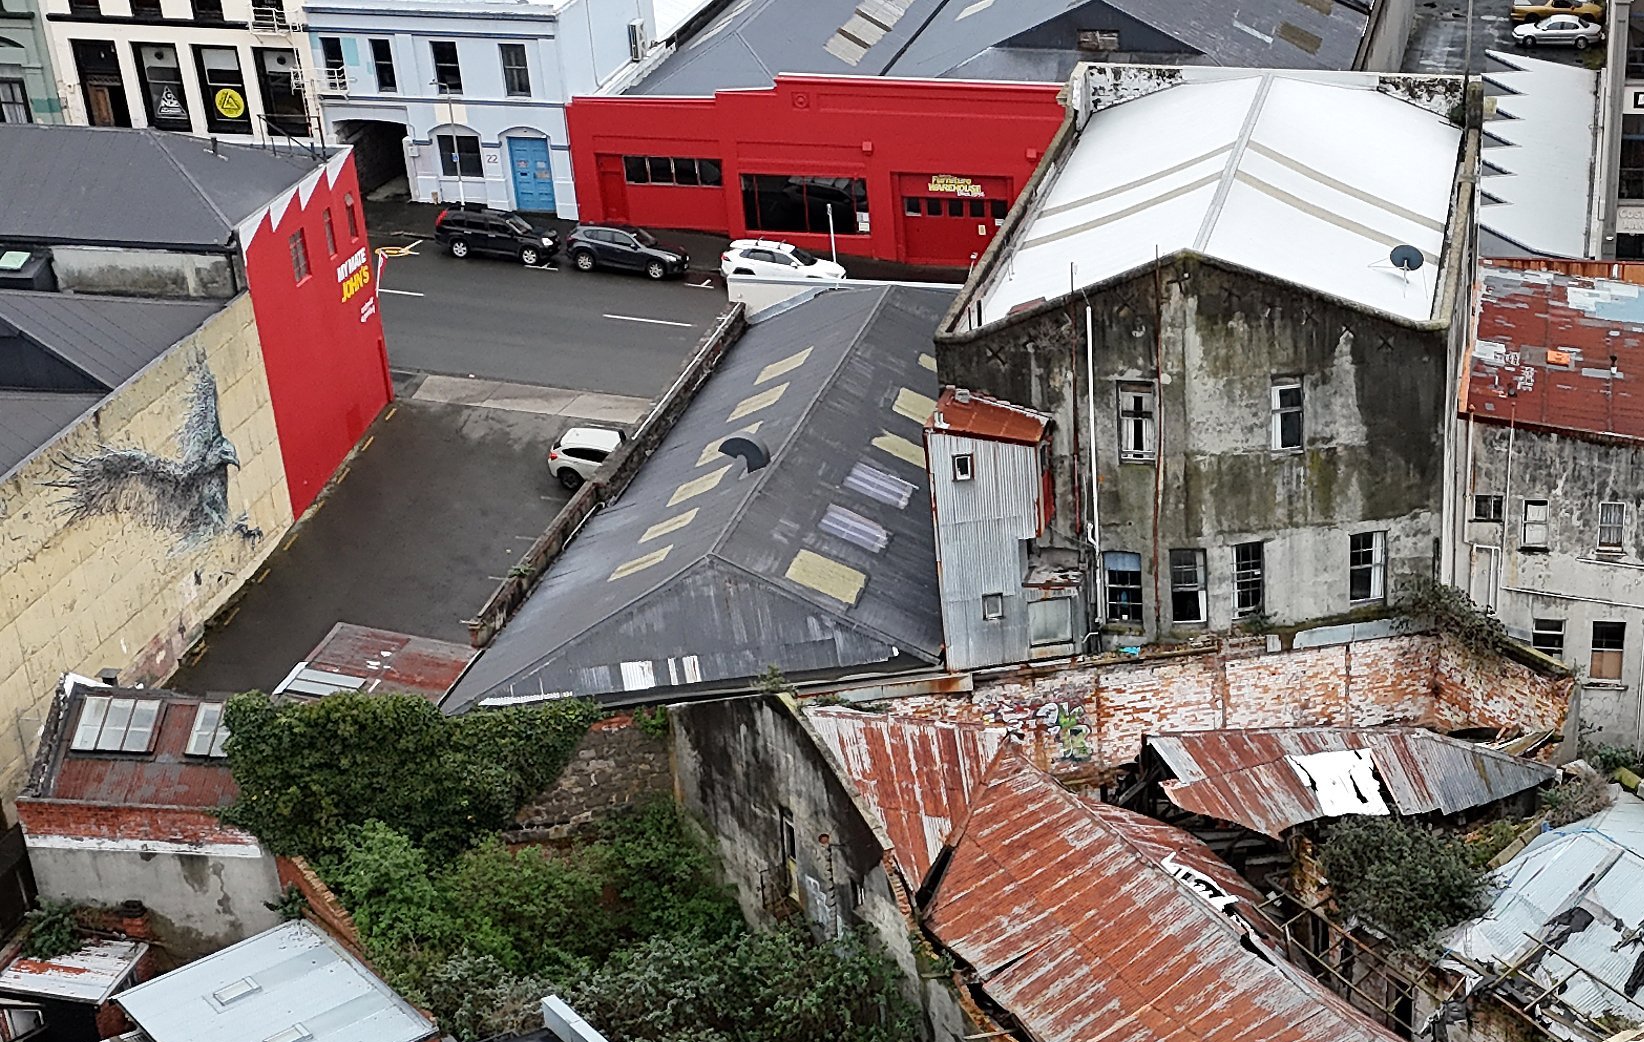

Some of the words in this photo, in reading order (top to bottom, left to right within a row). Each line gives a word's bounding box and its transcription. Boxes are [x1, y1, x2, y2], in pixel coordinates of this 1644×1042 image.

[486, 154, 499, 164] 22
[928, 183, 982, 193] WAREHOUSE
[342, 264, 370, 303] JOHN'S
